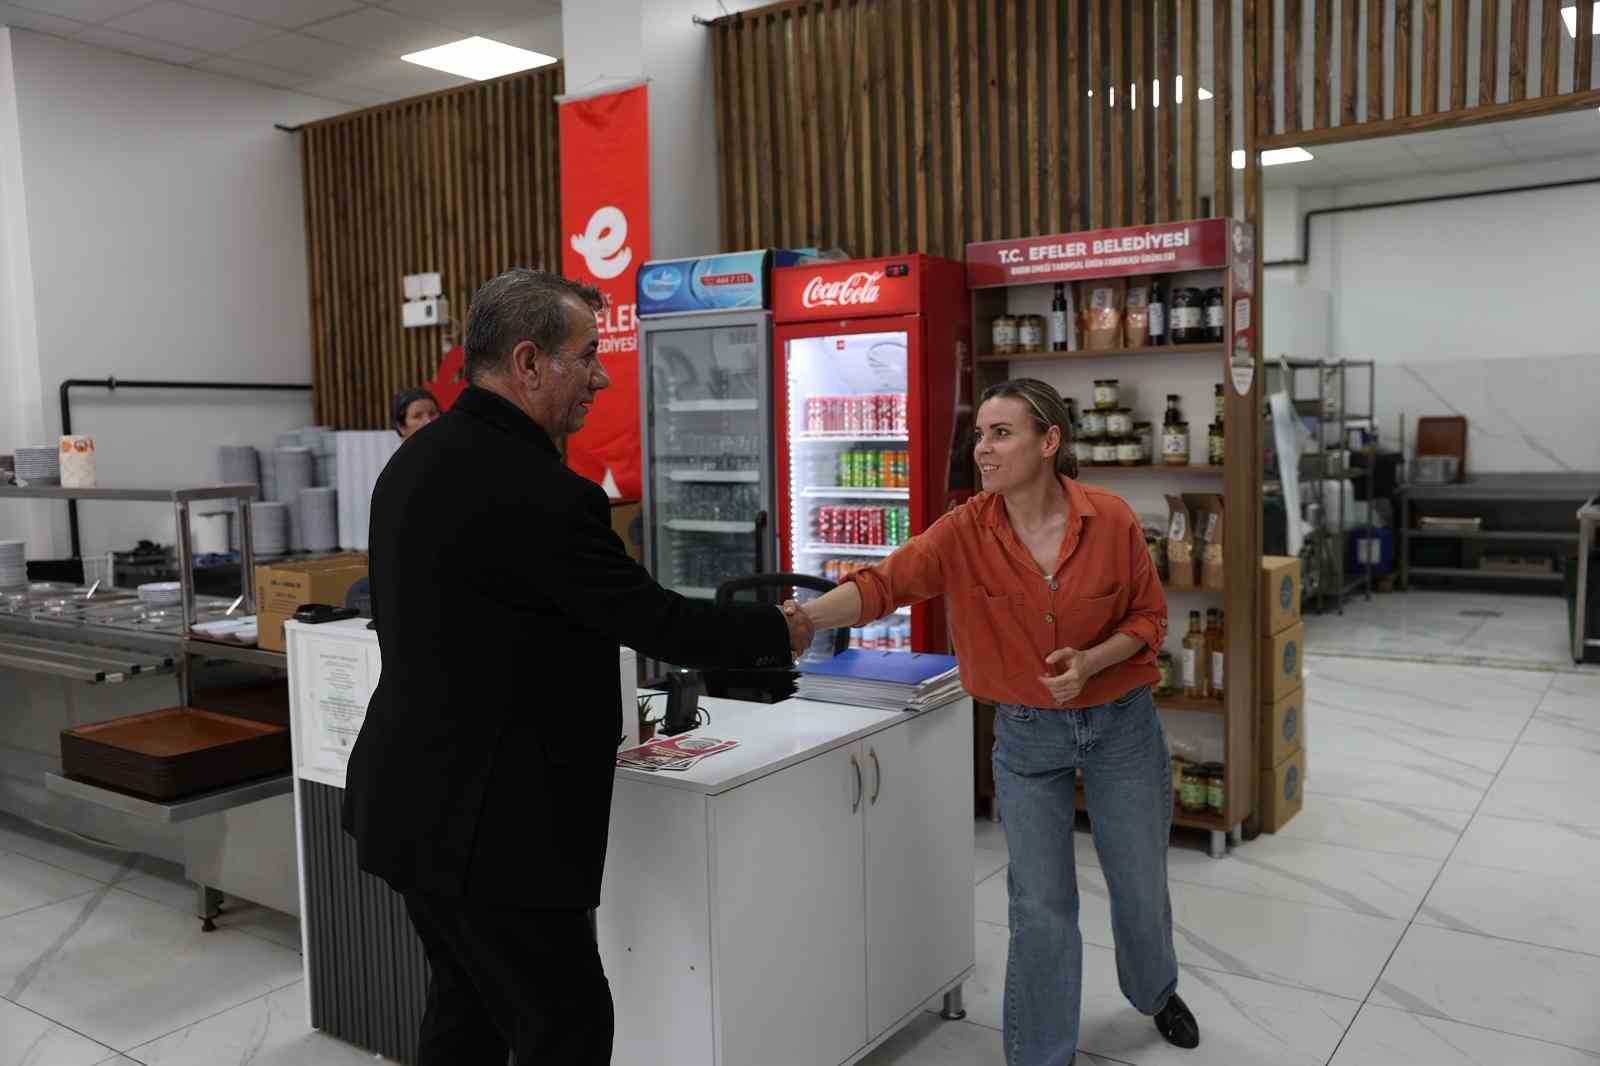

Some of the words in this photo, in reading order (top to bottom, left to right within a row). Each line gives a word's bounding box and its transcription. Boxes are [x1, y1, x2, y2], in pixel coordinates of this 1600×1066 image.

[998, 248, 1024, 264] T.C.
[1029, 242, 1087, 261] EFELER
[1092, 227, 1190, 255] BELEDİYESİ
[802, 271, 885, 309] Coca-Cola
[595, 304, 638, 333] ELE
[597, 334, 638, 353] EDİYESİ
